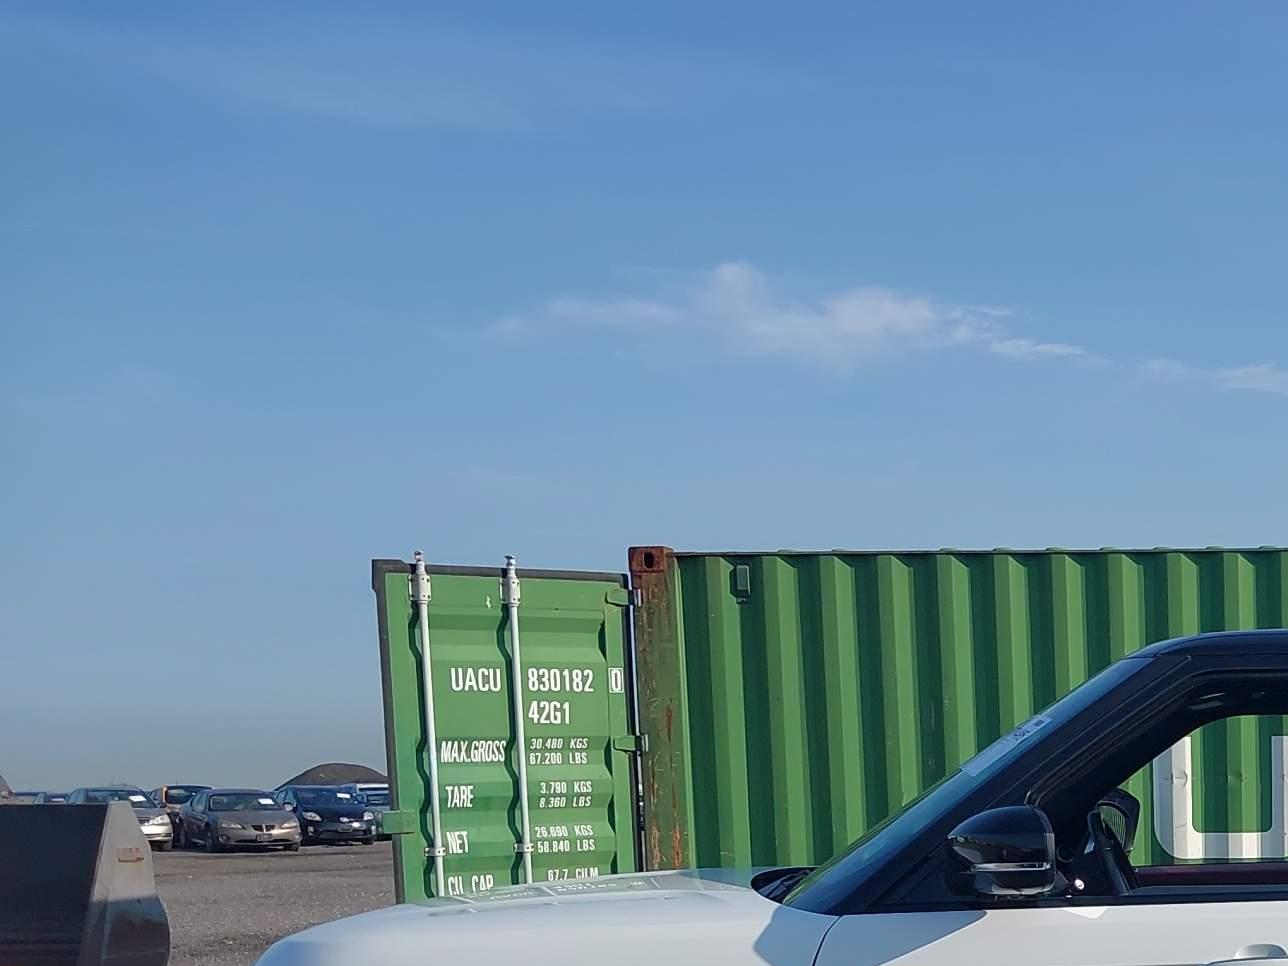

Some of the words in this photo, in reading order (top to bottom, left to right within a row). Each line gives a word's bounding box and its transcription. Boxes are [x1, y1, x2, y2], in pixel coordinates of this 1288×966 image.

[451, 667, 501, 692] UACU
[527, 668, 594, 692] 830182
[610, 668, 623, 692] 0
[528, 701, 570, 724] 42G1
[530, 738, 563, 749] 30.480
[569, 738, 589, 749] KGS
[440, 740, 507, 763] MAX.GROSS
[529, 752, 563, 765] 67.200
[569, 752, 588, 764] LBS
[573, 781, 593, 793] KGS
[445, 785, 474, 808] TARE
[572, 796, 592, 807] LBS
[574, 825, 594, 837] KGS
[446, 831, 469, 854] NET
[577, 839, 596, 851] LBS
